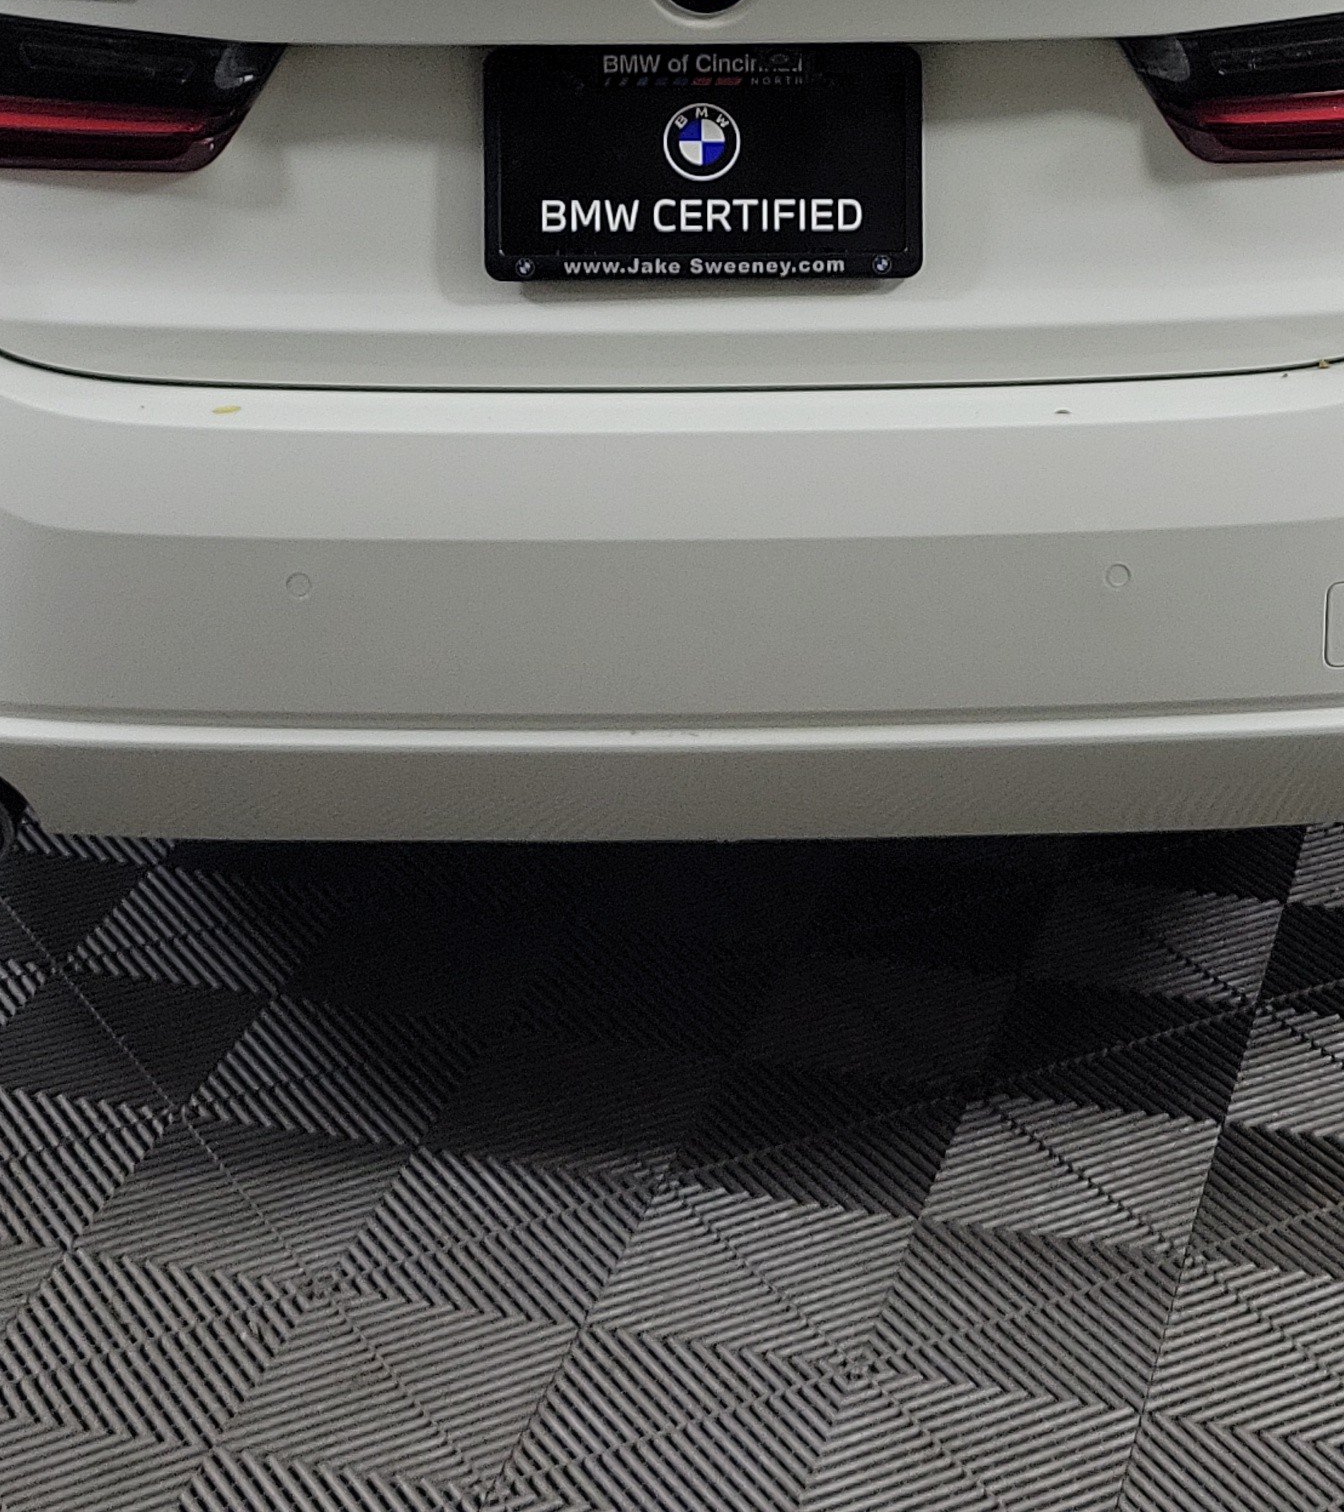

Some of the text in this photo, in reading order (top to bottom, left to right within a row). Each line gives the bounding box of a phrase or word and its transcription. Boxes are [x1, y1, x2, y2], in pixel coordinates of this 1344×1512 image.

[603, 54, 661, 73] BMW
[668, 54, 689, 73] of
[675, 107, 730, 129] BMW
[541, 199, 863, 232] BMW CERTIFIED
[564, 258, 845, 276] www.Jake Sweeney.com
